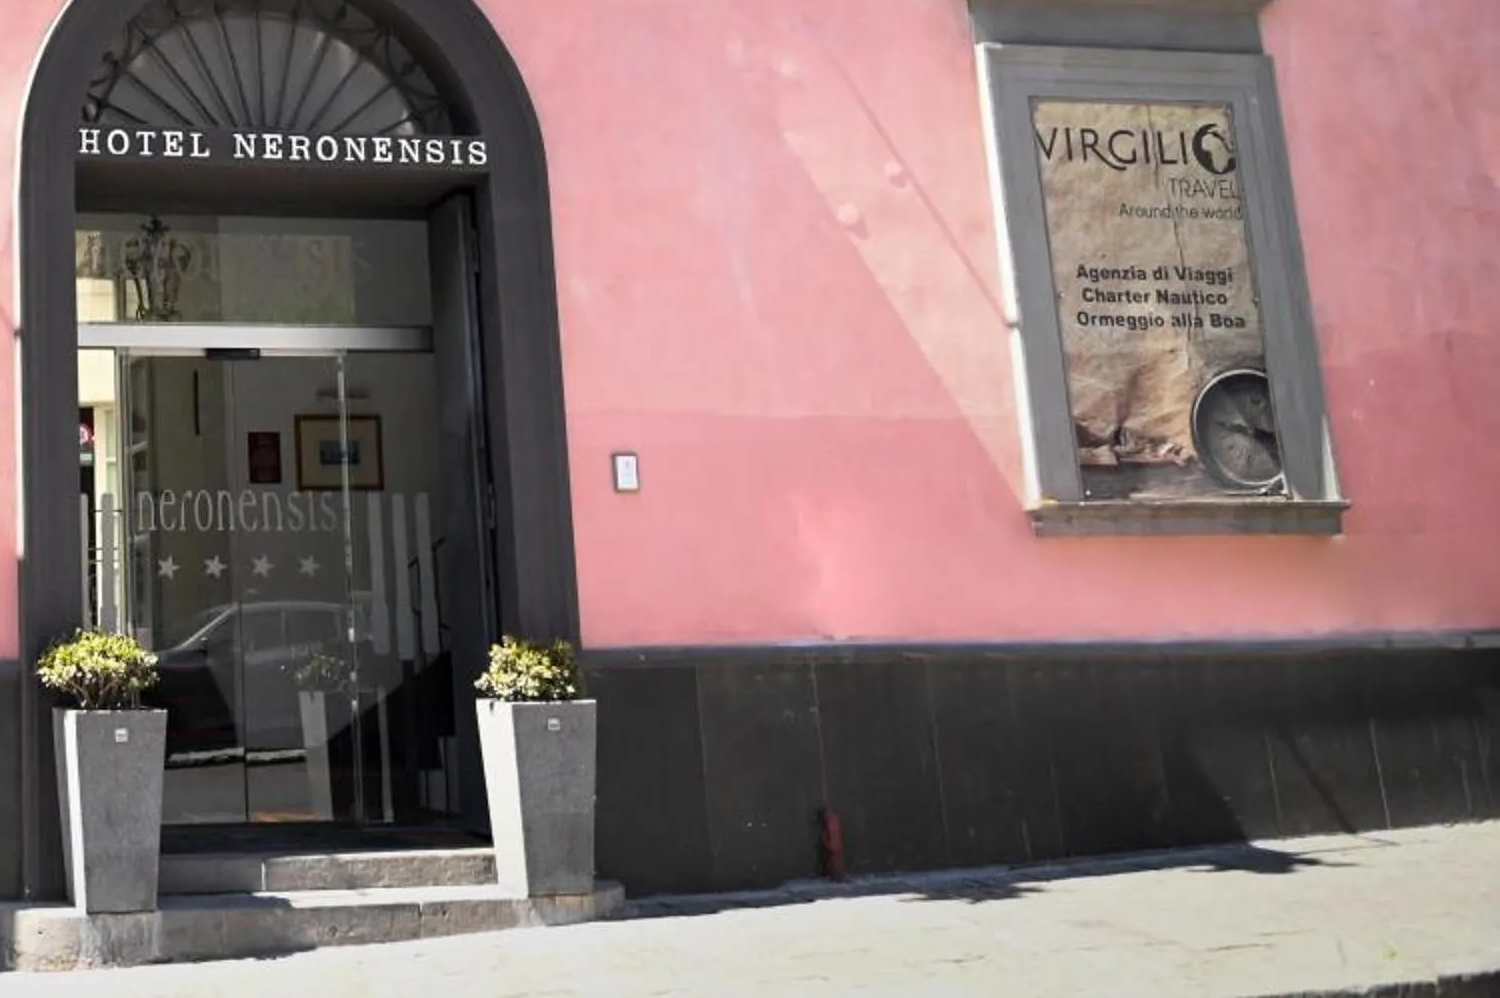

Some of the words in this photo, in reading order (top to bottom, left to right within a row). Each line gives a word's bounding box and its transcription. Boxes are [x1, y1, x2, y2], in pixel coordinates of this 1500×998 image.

[79, 128, 211, 158] HOTEL
[234, 133, 488, 166] NERONENSIS
[1035, 123, 1236, 175] VIRGILIO
[1169, 178, 1241, 200] TRAVEL
[1119, 202, 1171, 219] Around
[1174, 203, 1199, 219] the
[1201, 205, 1243, 221] world
[1076, 264, 1147, 283] Agenzia
[1152, 266, 1169, 281] di
[1174, 266, 1234, 286] Viaggi
[1082, 287, 1151, 304] Charter
[1156, 289, 1228, 305] Nautico
[1076, 311, 1165, 331] Ormeggio
[1171, 312, 1204, 328] alla
[1210, 313, 1247, 330] Boa
[137, 489, 338, 532] neronensis
